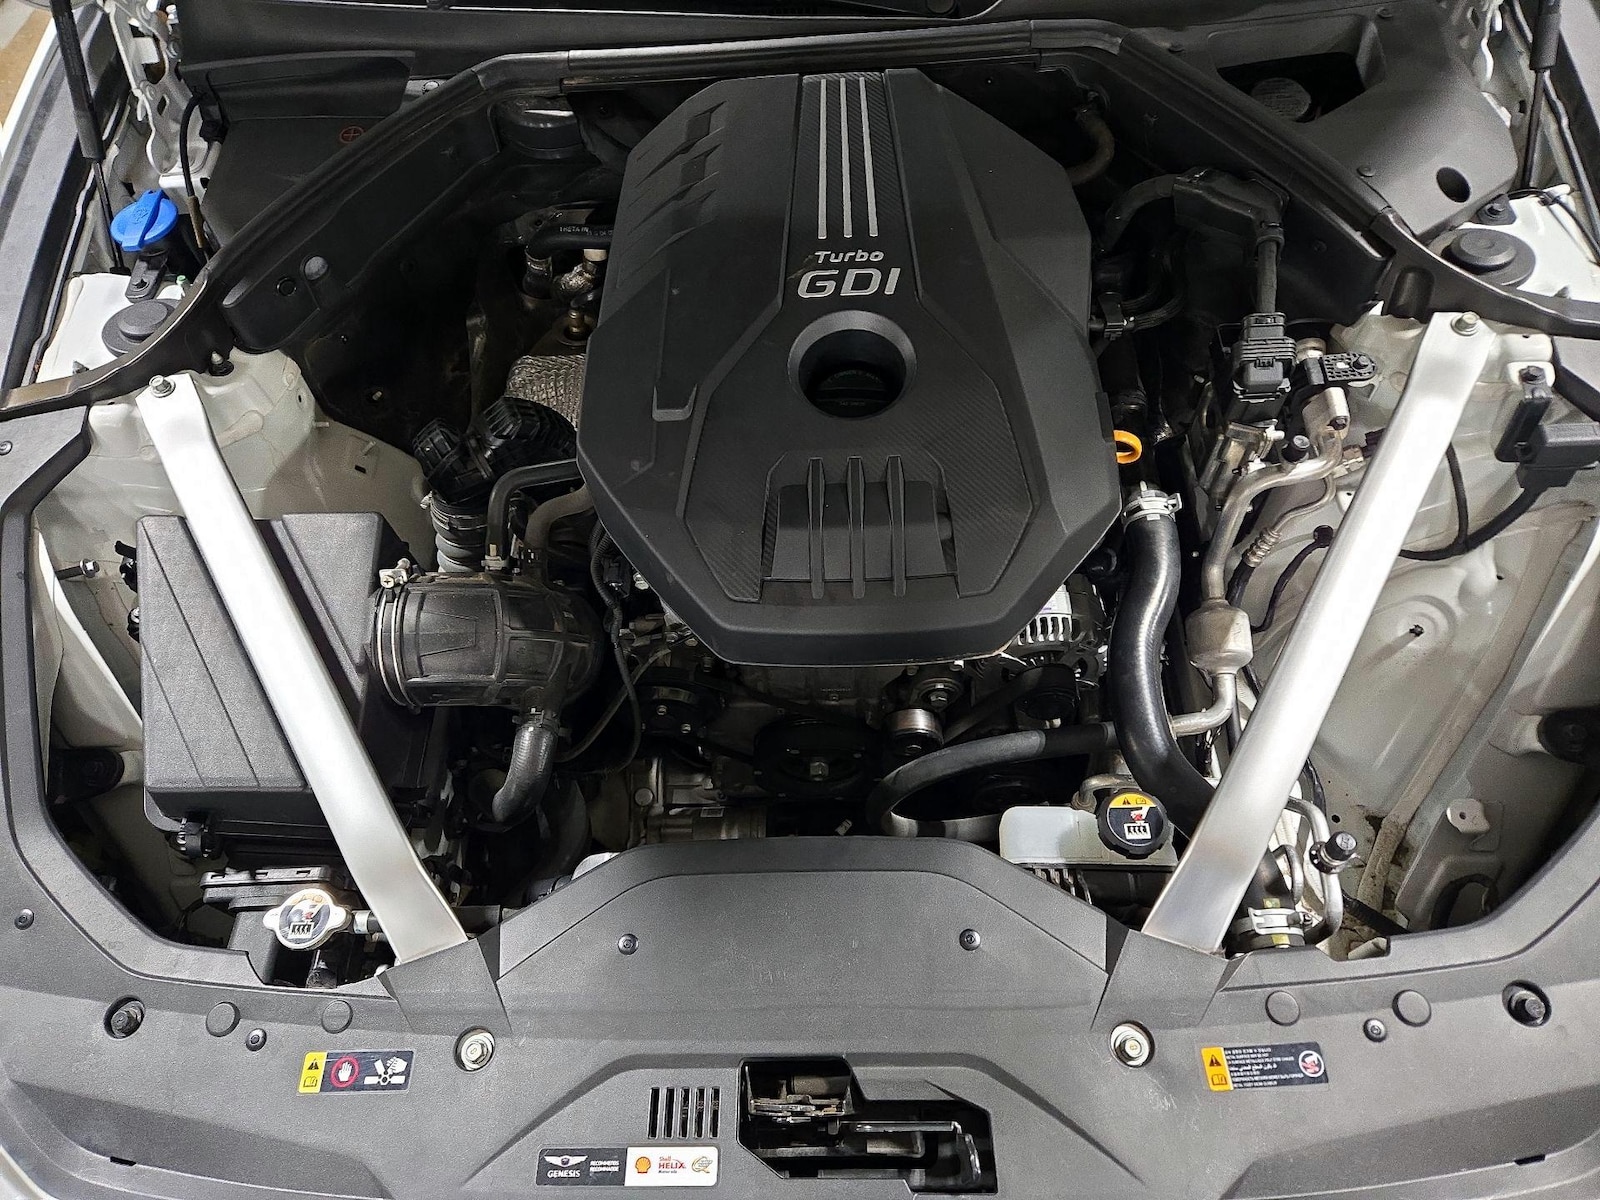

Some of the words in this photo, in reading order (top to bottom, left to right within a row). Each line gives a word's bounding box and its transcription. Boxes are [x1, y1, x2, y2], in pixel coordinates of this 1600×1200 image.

[815, 250, 884, 263] Turbo
[797, 268, 901, 298] GDI
[547, 1170, 581, 1178] GENESIS
